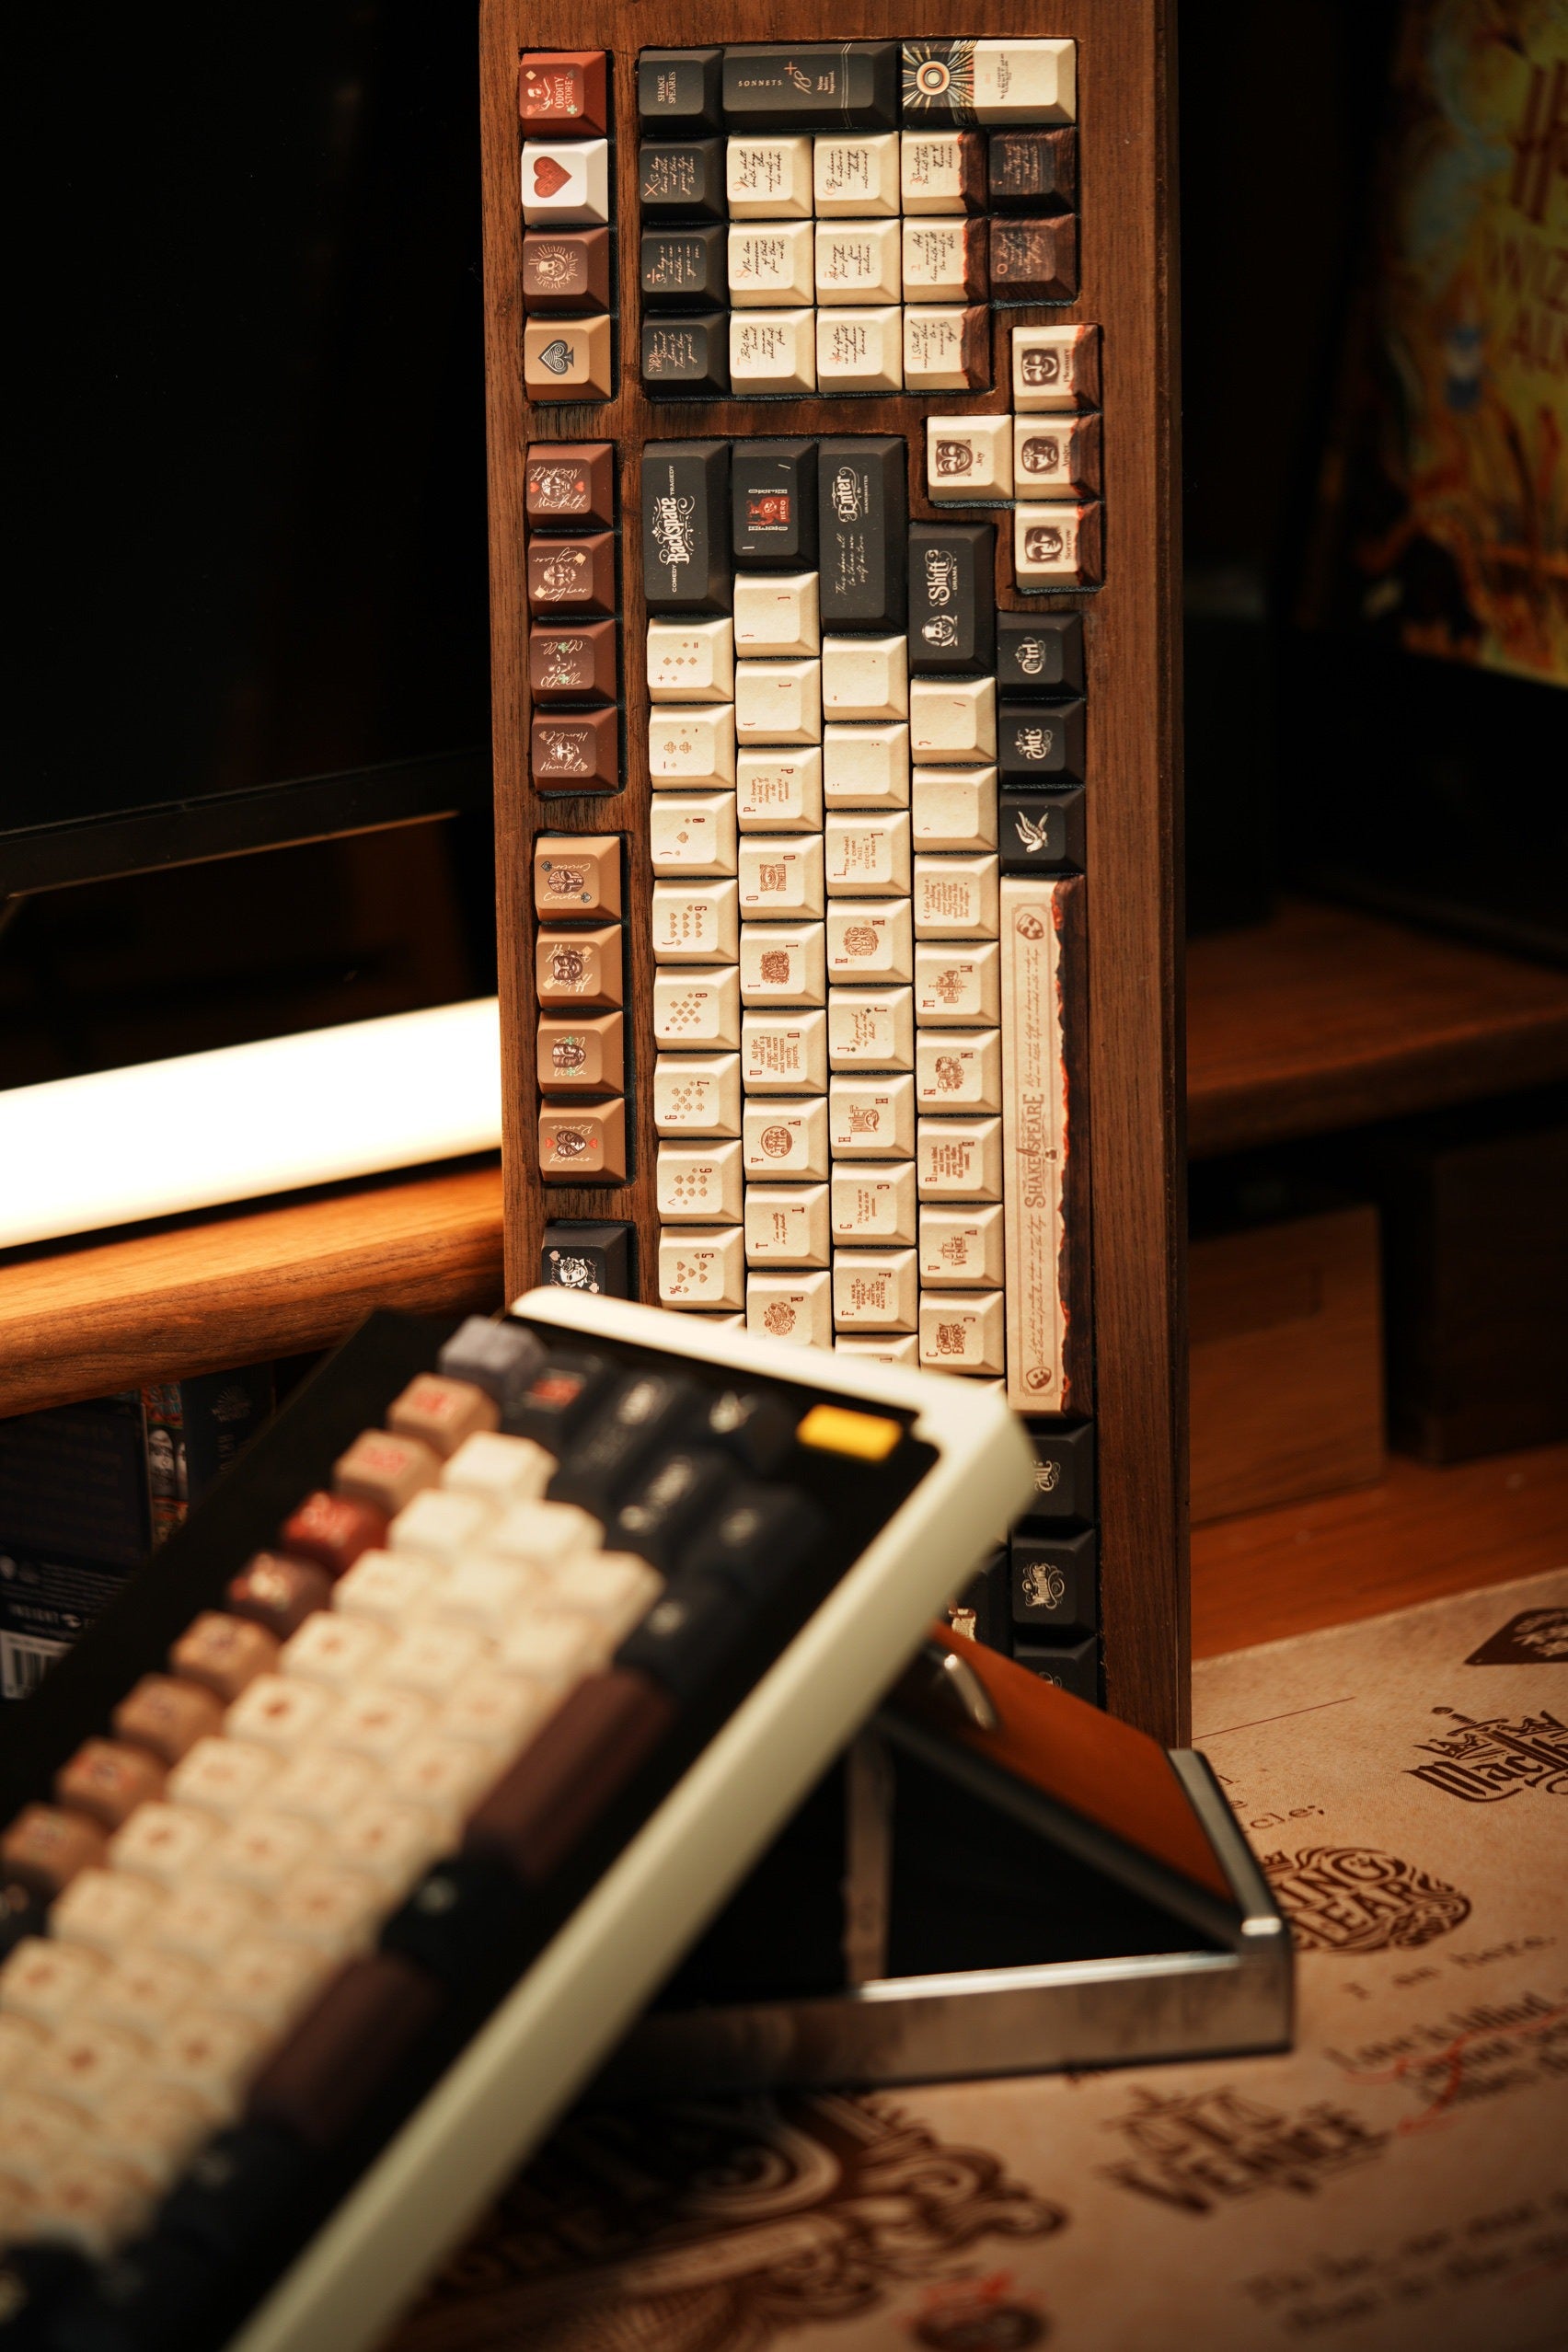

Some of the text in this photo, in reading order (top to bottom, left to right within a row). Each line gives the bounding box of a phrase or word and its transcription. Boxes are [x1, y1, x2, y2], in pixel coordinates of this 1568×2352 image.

[554, 76, 564, 109] ODDITY
[565, 80, 573, 104] STORE
[657, 75, 665, 102] SHAKE
[668, 71, 676, 104] SPEARES
[738, 79, 783, 87] SONNETS
[793, 71, 812, 94] 18
[1062, 348, 1070, 383] Pleasure
[975, 452, 985, 467] Joy
[1062, 443, 1070, 467] Anger
[836, 475, 858, 521] Enter
[659, 497, 690, 565] Backspace
[927, 561, 951, 601] Shift
[541, 639, 584, 655] Othllo
[1020, 641, 1043, 674] Ctrl
[540, 673, 583, 687] Othllo
[775, 864, 787, 891] OTHELLO
[850, 927, 862, 953] KING
[859, 930, 872, 951] LEAR
[942, 971, 959, 1003] Macbeth
[953, 1237, 966, 1266] VENICE
[856, 1278, 860, 1287] TO
[875, 1281, 880, 1291] NO
[939, 1323, 951, 1355] COMEDY
[951, 1324, 965, 1355] ERRORS
[1030, 1563, 1051, 1607] Windows
[1250, 1804, 1325, 1831] cle;
[1277, 1852, 1406, 1912] ING
